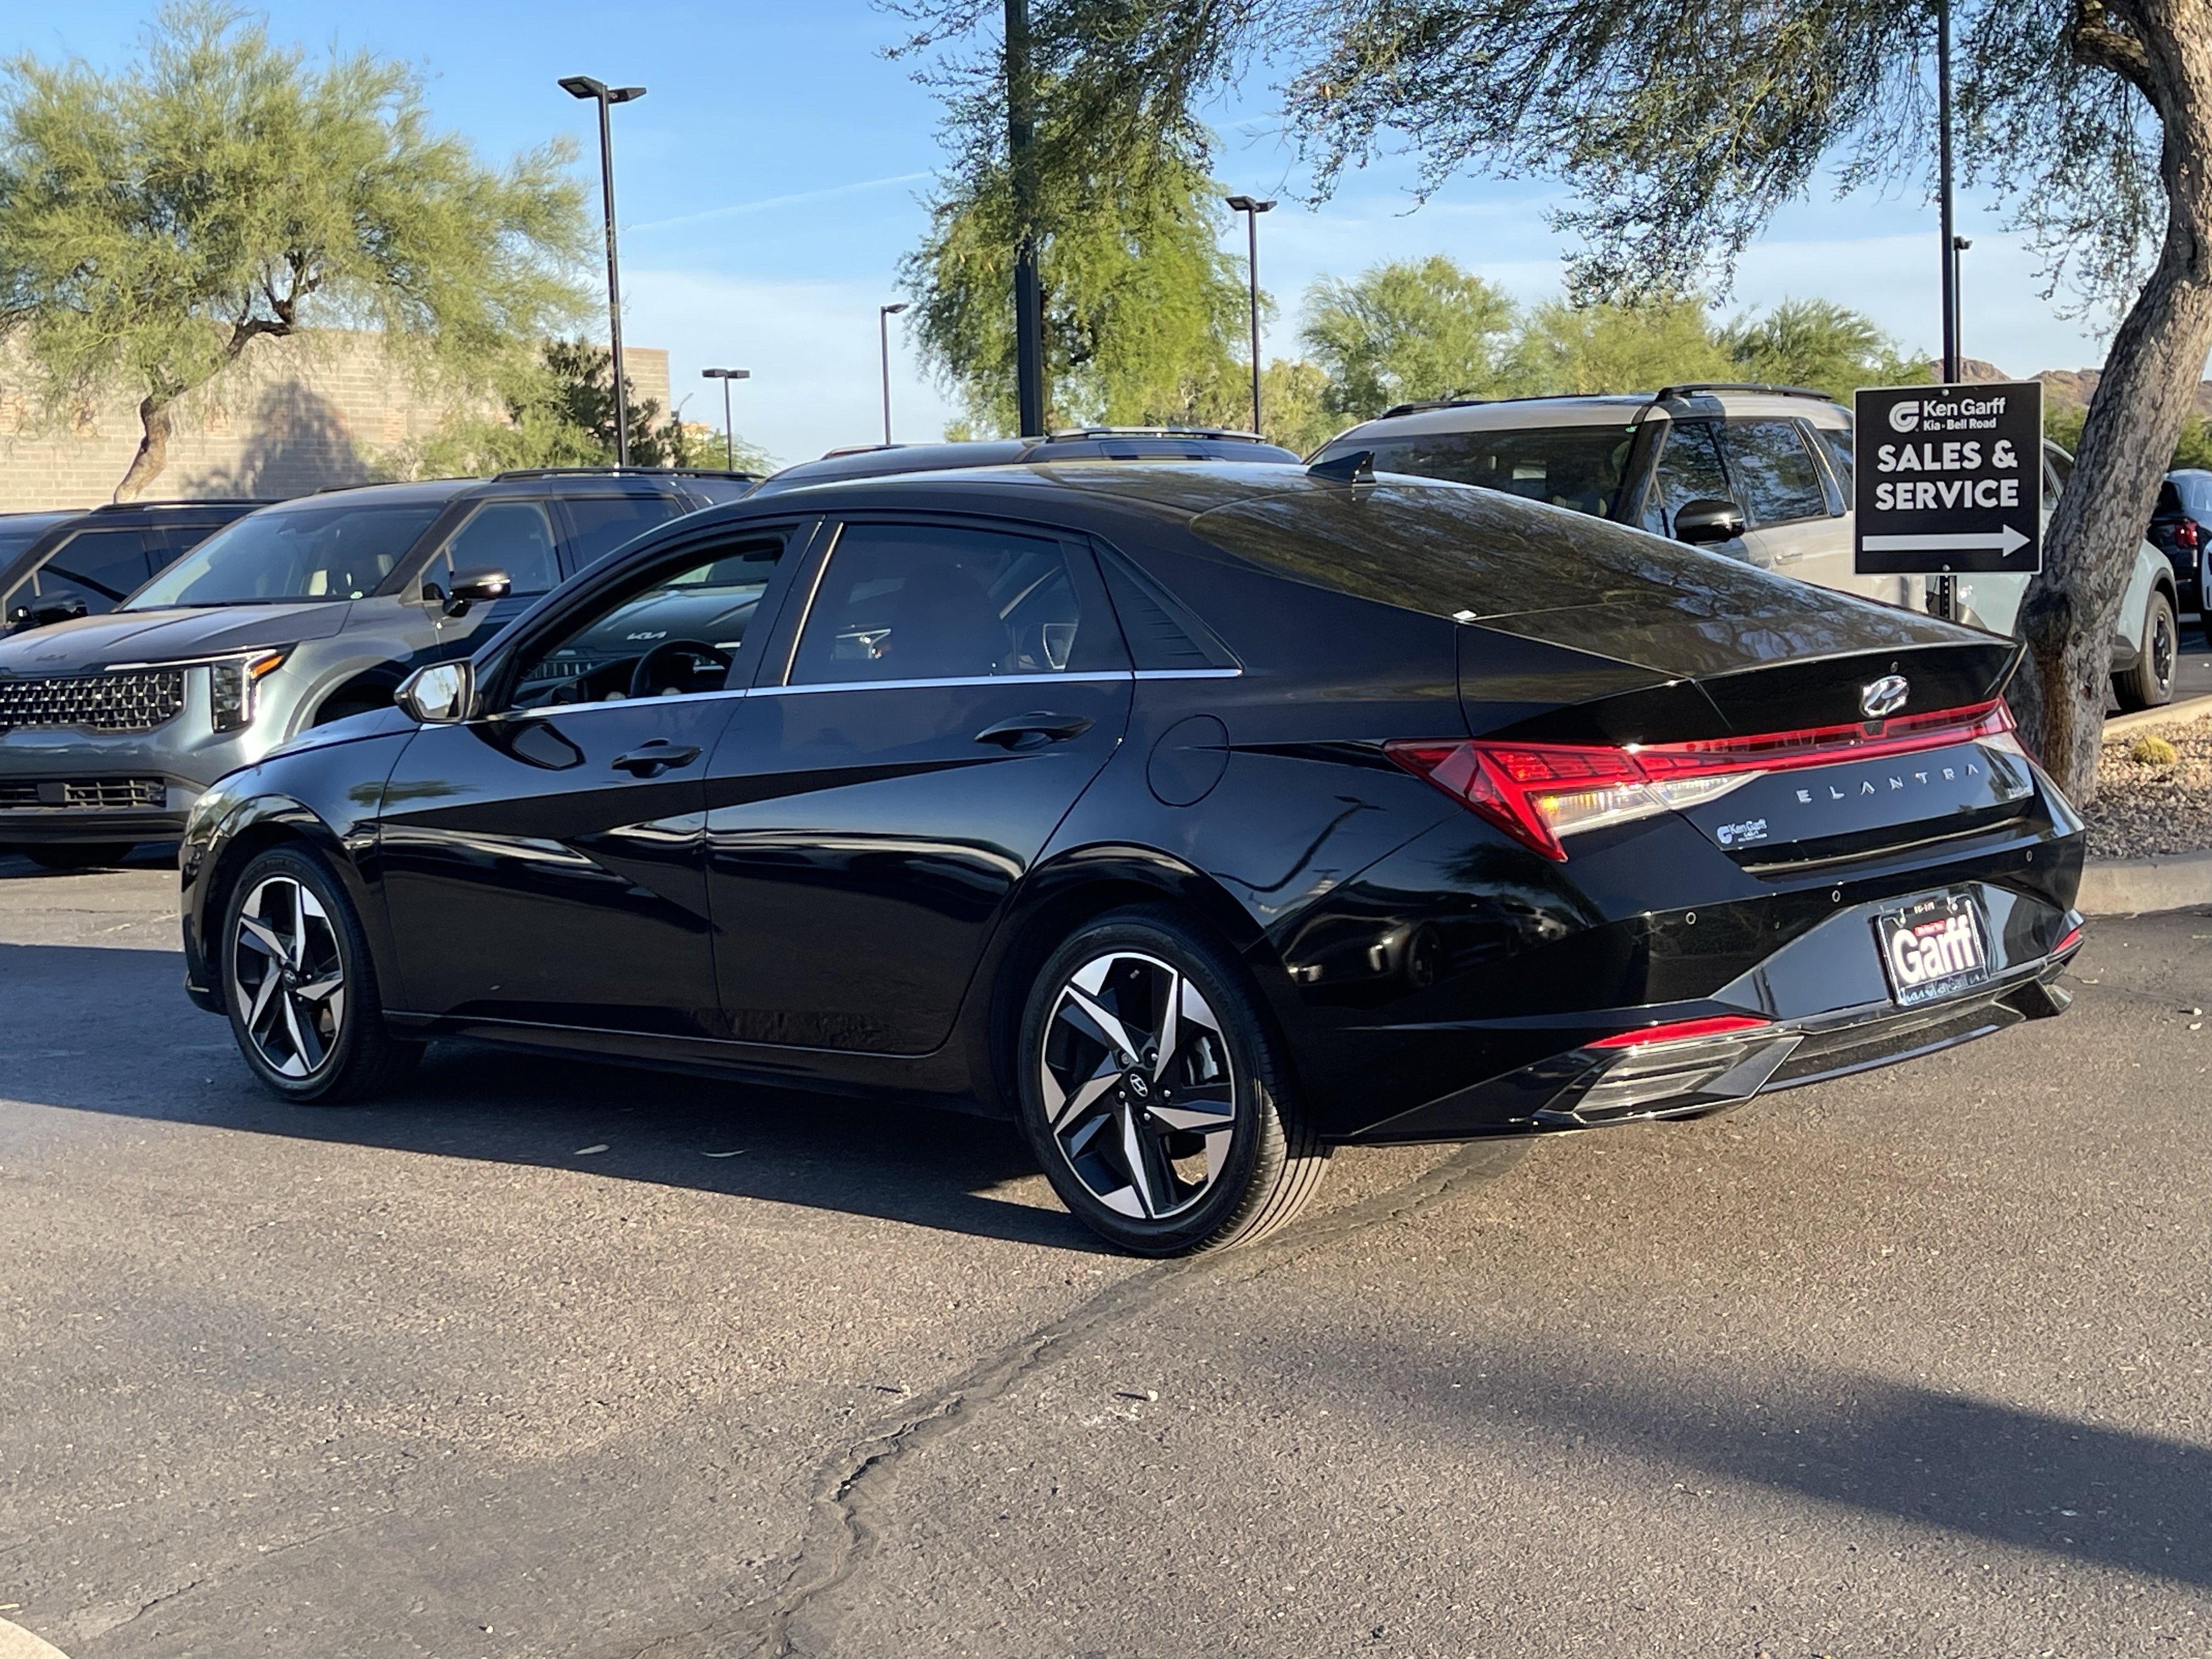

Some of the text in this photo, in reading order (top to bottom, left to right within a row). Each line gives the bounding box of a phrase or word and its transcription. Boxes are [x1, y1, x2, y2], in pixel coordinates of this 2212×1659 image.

[1923, 400, 1958, 417] Ken
[1960, 397, 2006, 415] Garff
[1969, 417, 1996, 429] Road
[1877, 439, 2018, 472] SALES &
[1875, 479, 2019, 510] SERVICE
[1796, 764, 1978, 804] ELANTRA
[1893, 913, 1976, 984] Garff
